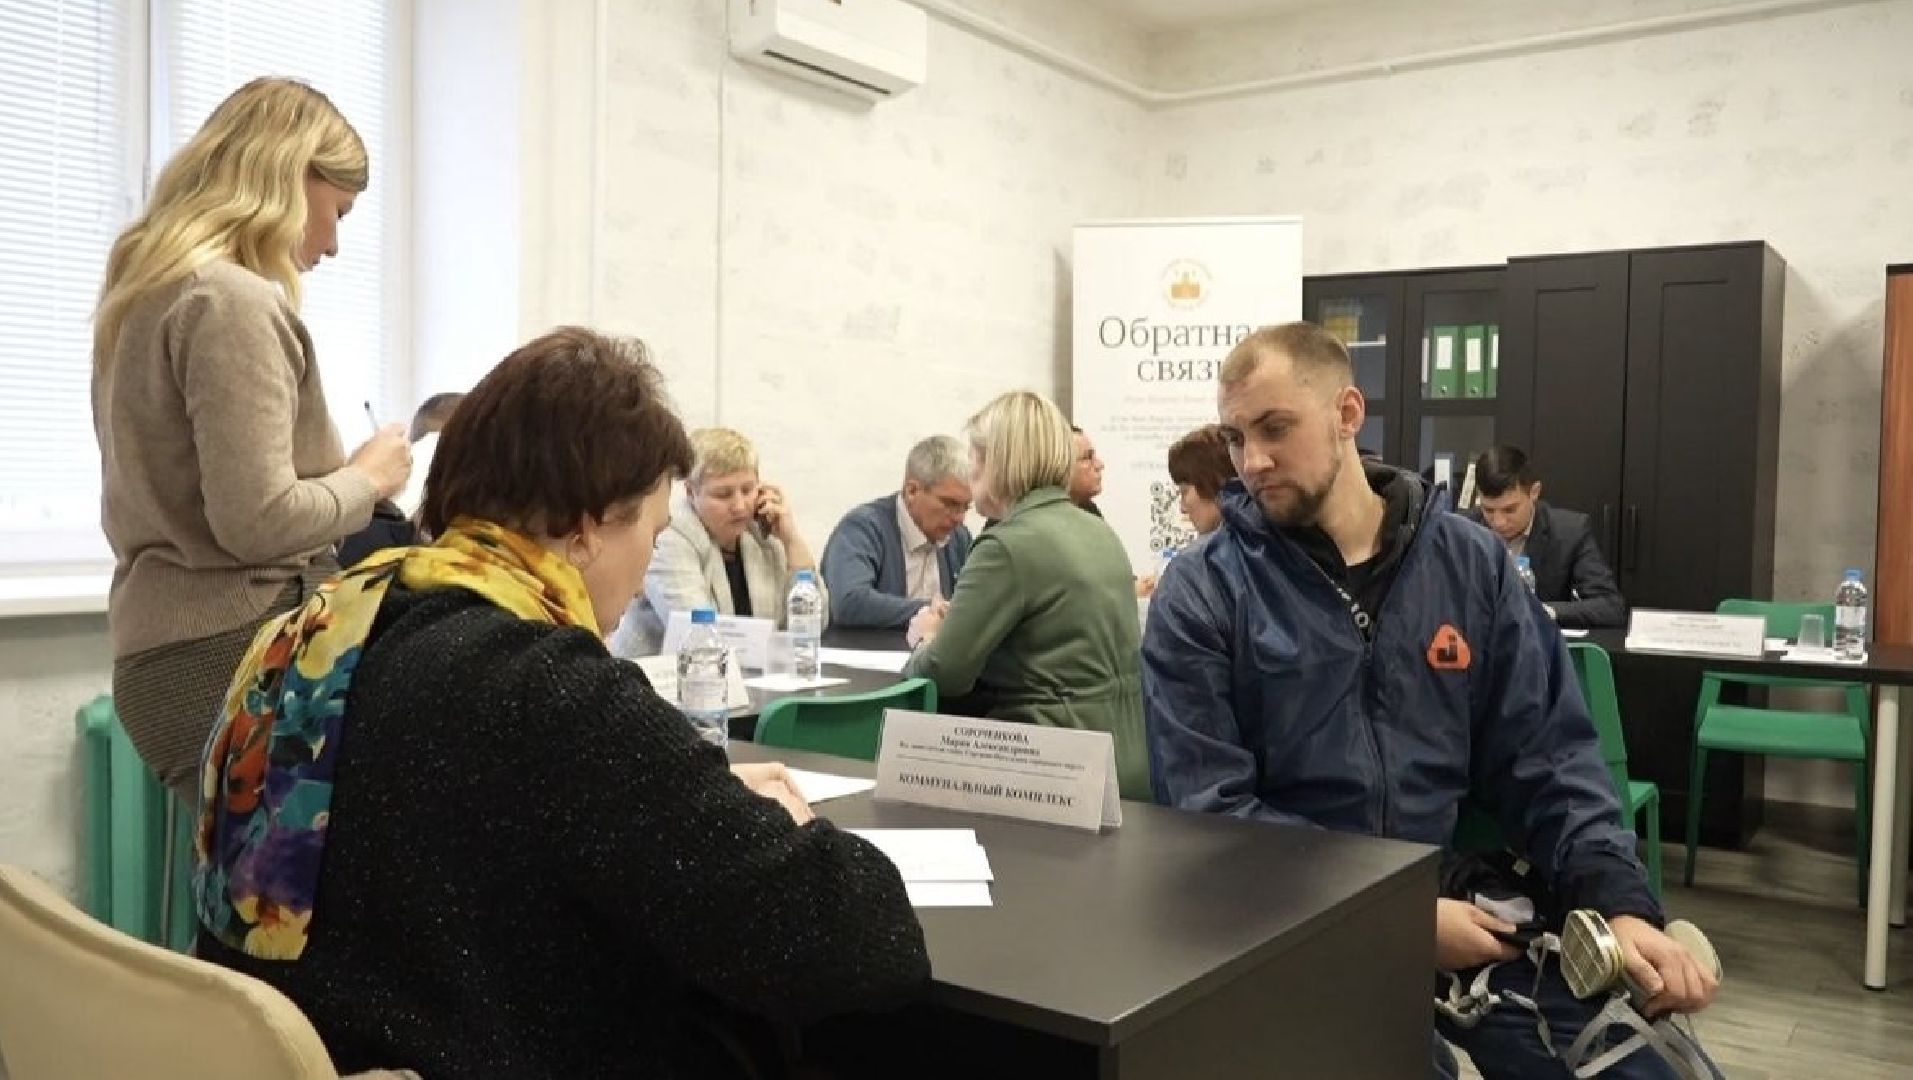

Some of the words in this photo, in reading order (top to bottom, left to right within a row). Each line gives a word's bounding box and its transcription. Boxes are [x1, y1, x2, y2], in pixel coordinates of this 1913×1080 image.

[1099, 315, 1251, 356] Обратна
[899, 772, 1003, 797] КОММУНАЛЬНЫЙ
[1005, 787, 1075, 807] КОМПЛЕКС
